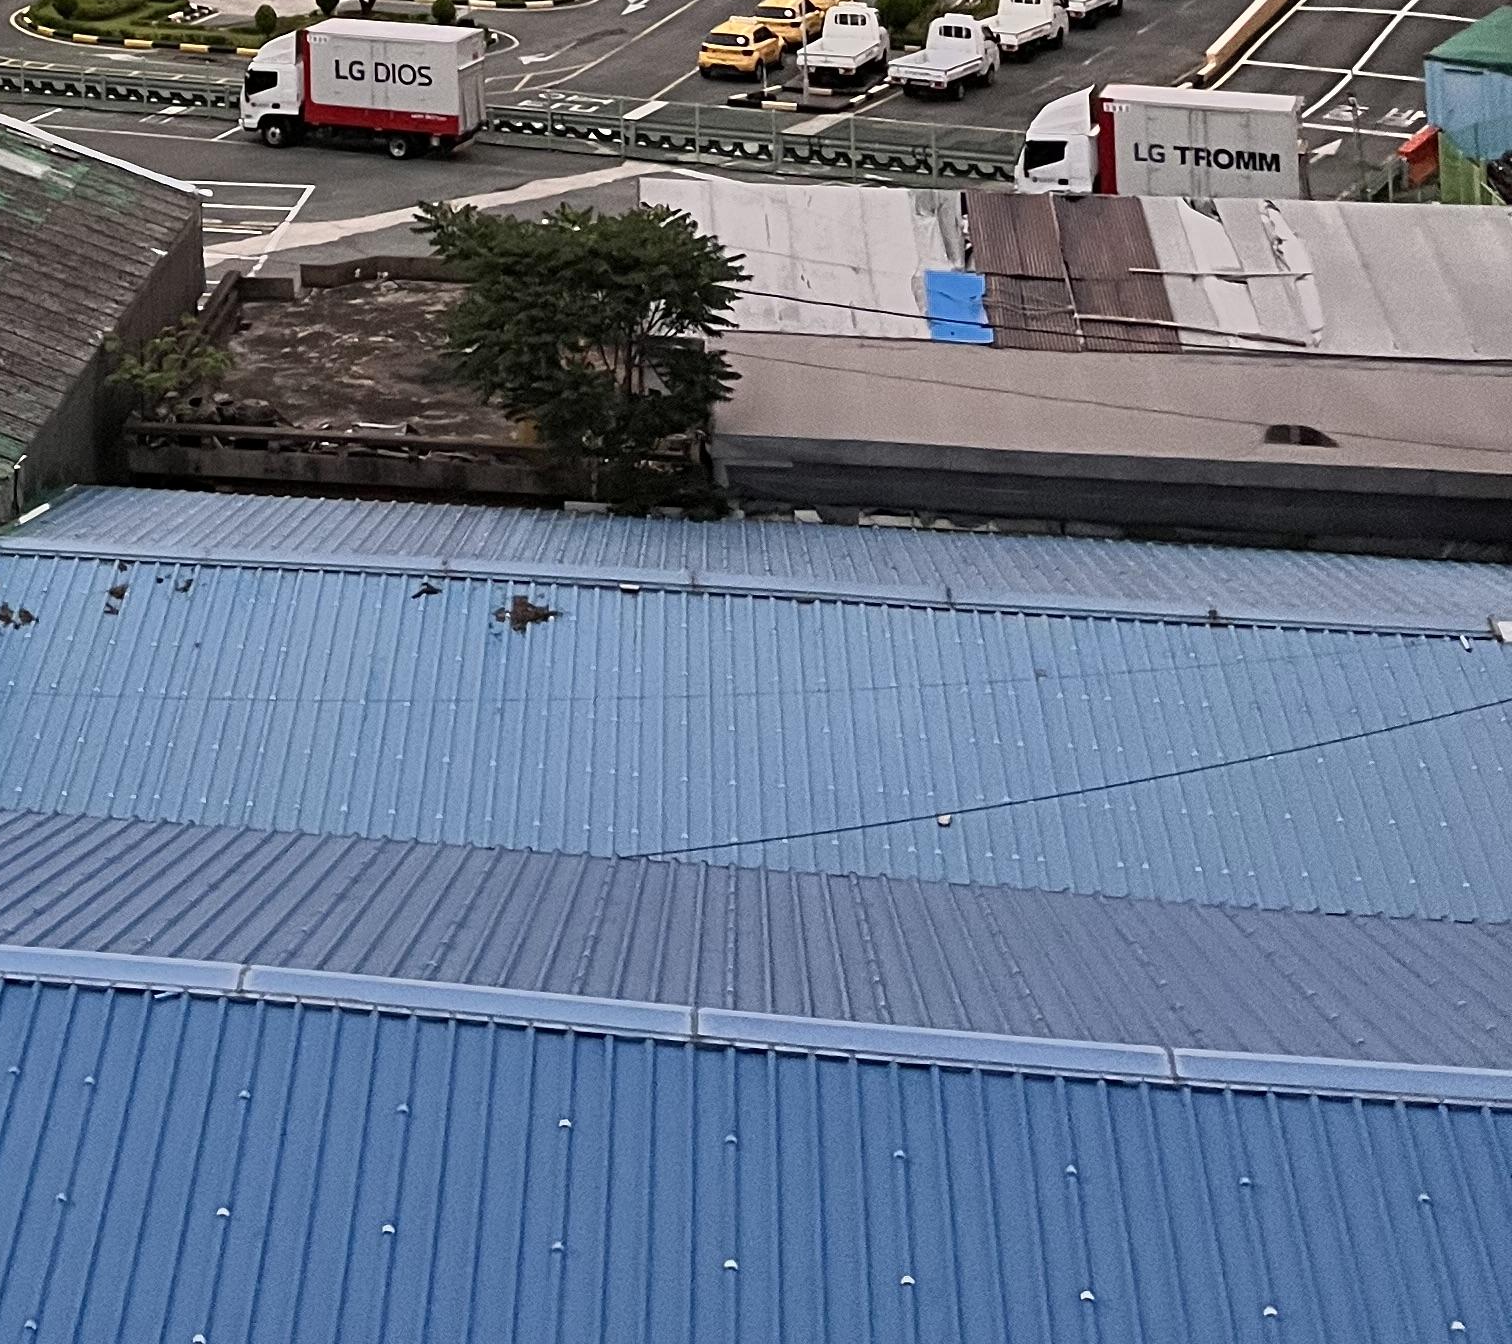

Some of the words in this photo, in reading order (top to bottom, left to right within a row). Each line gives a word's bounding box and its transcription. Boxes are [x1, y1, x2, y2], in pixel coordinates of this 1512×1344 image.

[334, 59, 365, 81] LG
[374, 62, 433, 87] DIOS
[1133, 142, 1166, 163] LG
[1173, 145, 1281, 173] TROMM
